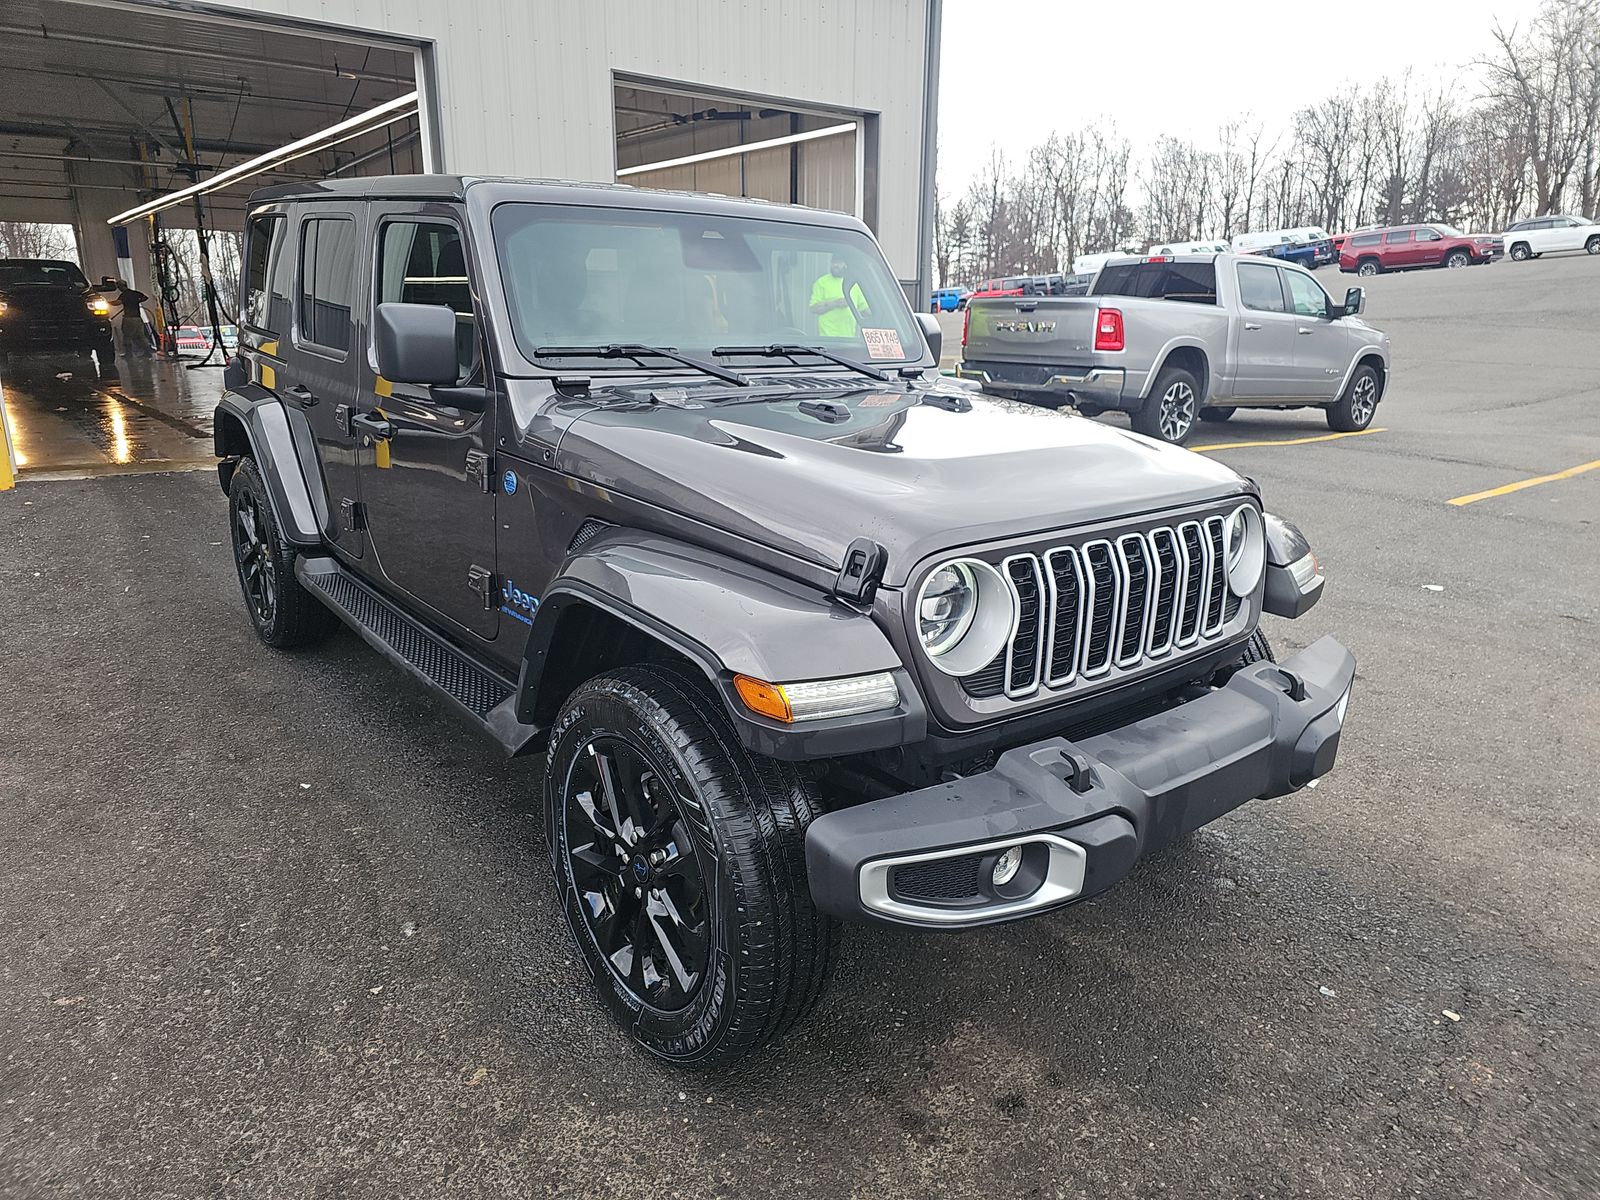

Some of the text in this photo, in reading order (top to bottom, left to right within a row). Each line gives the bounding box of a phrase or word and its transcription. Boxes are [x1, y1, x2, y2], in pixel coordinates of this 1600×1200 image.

[996, 321, 1056, 333] RAM
[501, 579, 540, 619] Jeep
[546, 707, 582, 764] NEXEN
